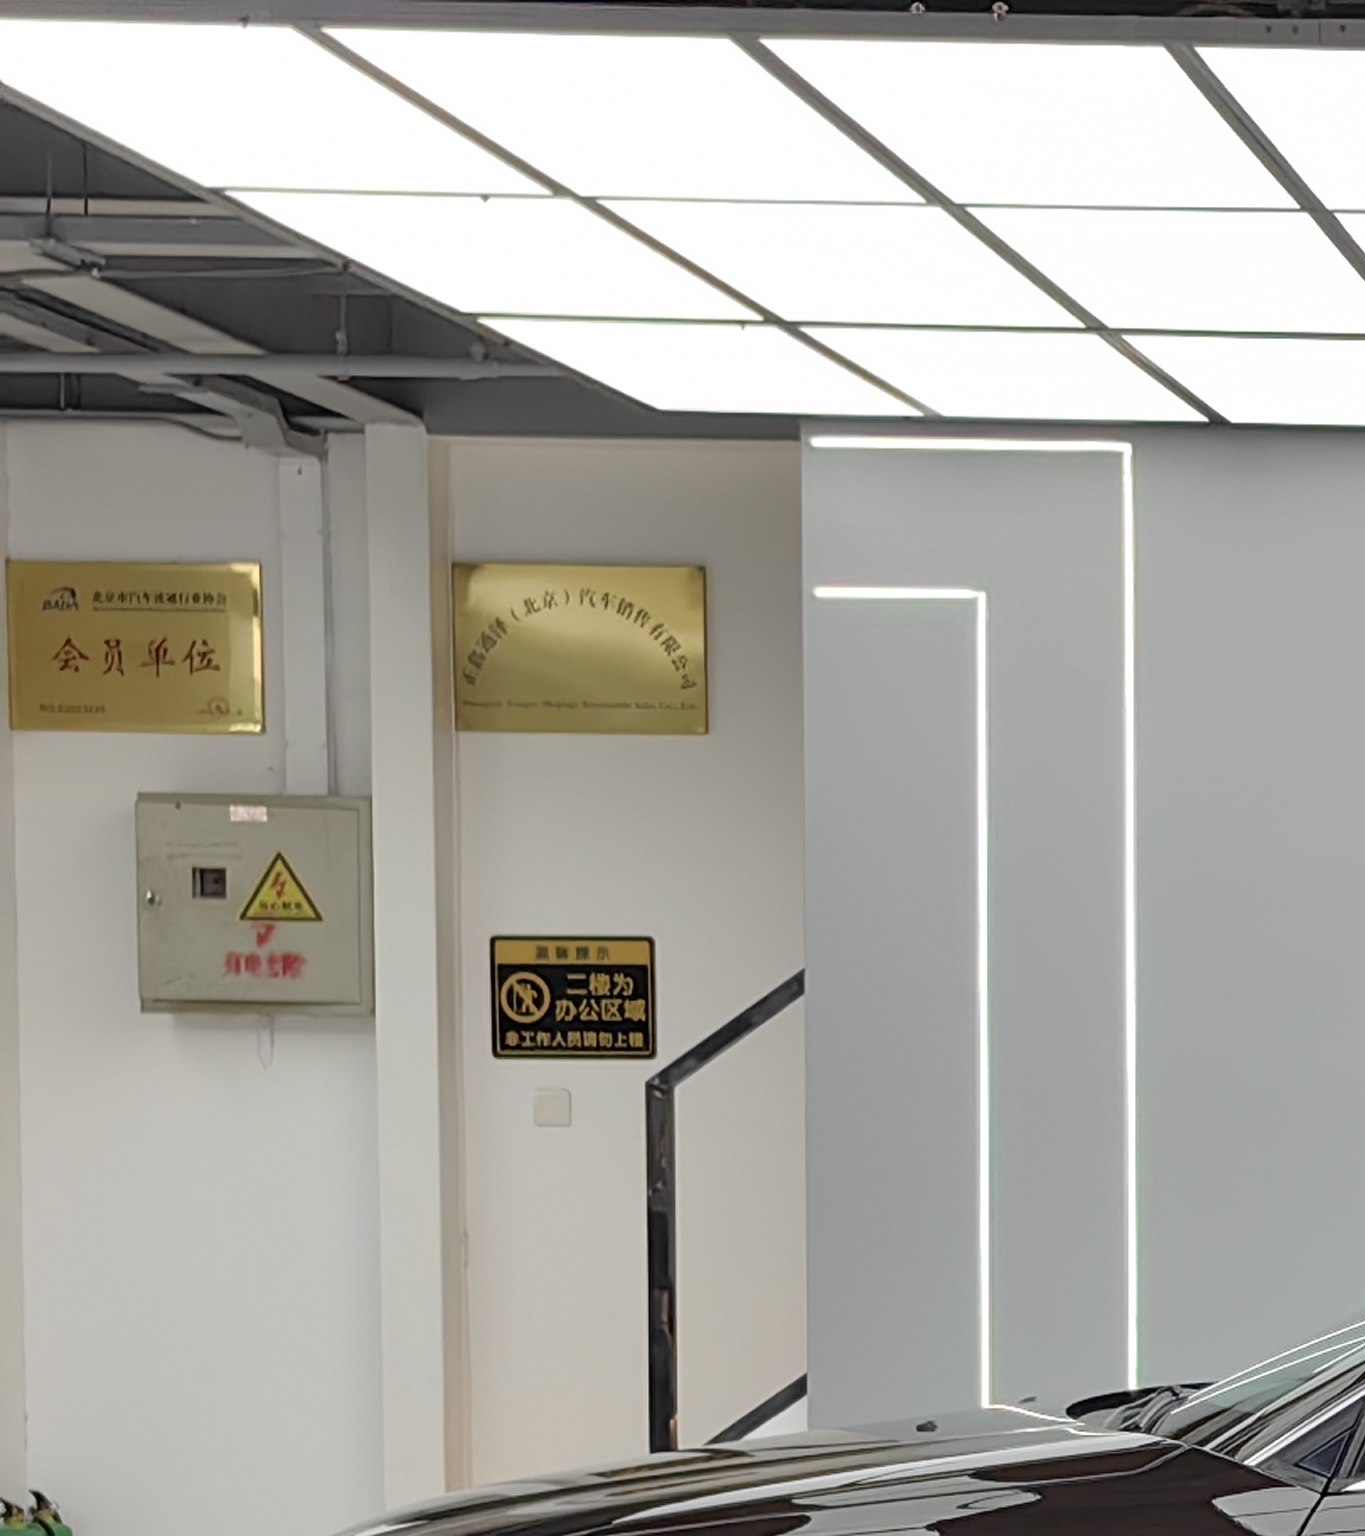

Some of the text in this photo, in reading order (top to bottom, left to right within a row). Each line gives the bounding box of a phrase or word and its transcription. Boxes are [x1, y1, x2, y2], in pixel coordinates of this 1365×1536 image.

[52, 636, 221, 677] 会员单位
[566, 972, 634, 996] 二楼为
[555, 998, 646, 1022] 办公区域
